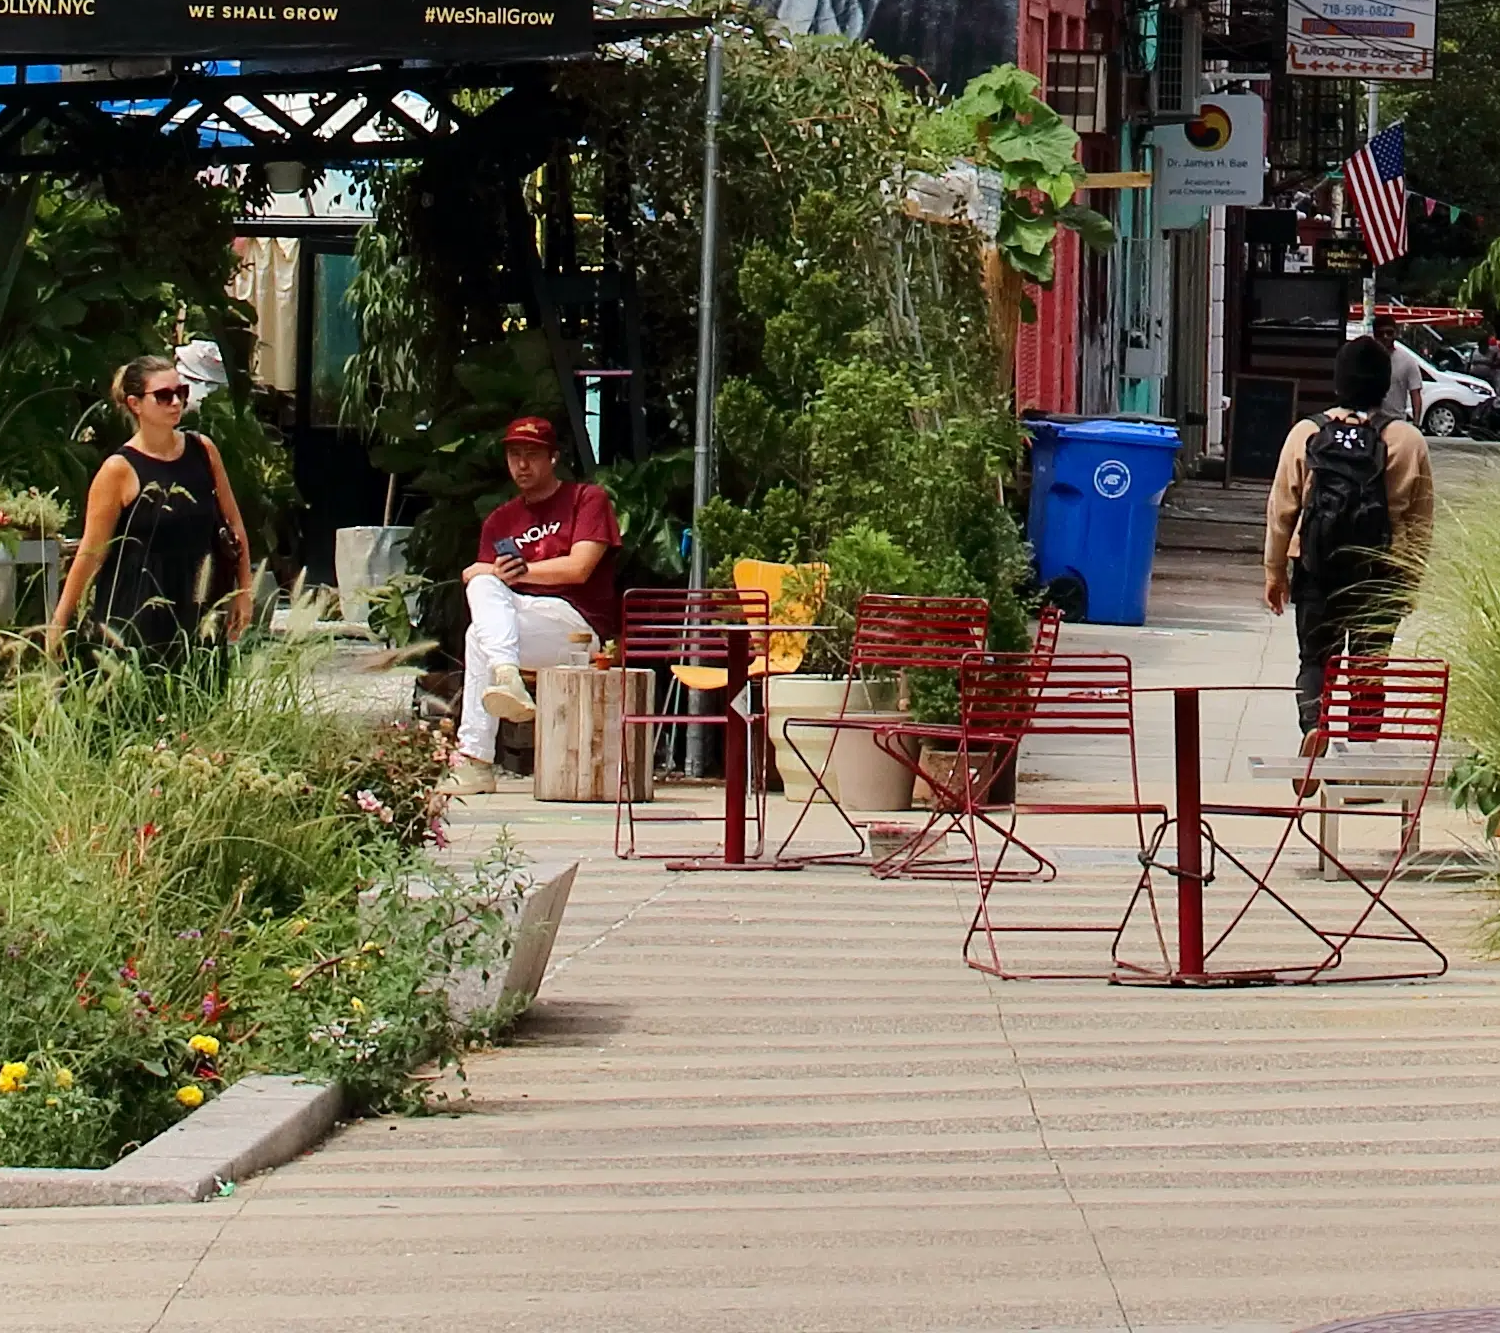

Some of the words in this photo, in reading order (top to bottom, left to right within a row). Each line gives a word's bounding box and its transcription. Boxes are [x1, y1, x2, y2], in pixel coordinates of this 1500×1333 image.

[188, 4, 216, 20] WE
[221, 4, 277, 21] SHALL
[282, 5, 340, 22] GROW
[424, 3, 556, 28] #WeShallGrow
[1183, 157, 1215, 169] James
